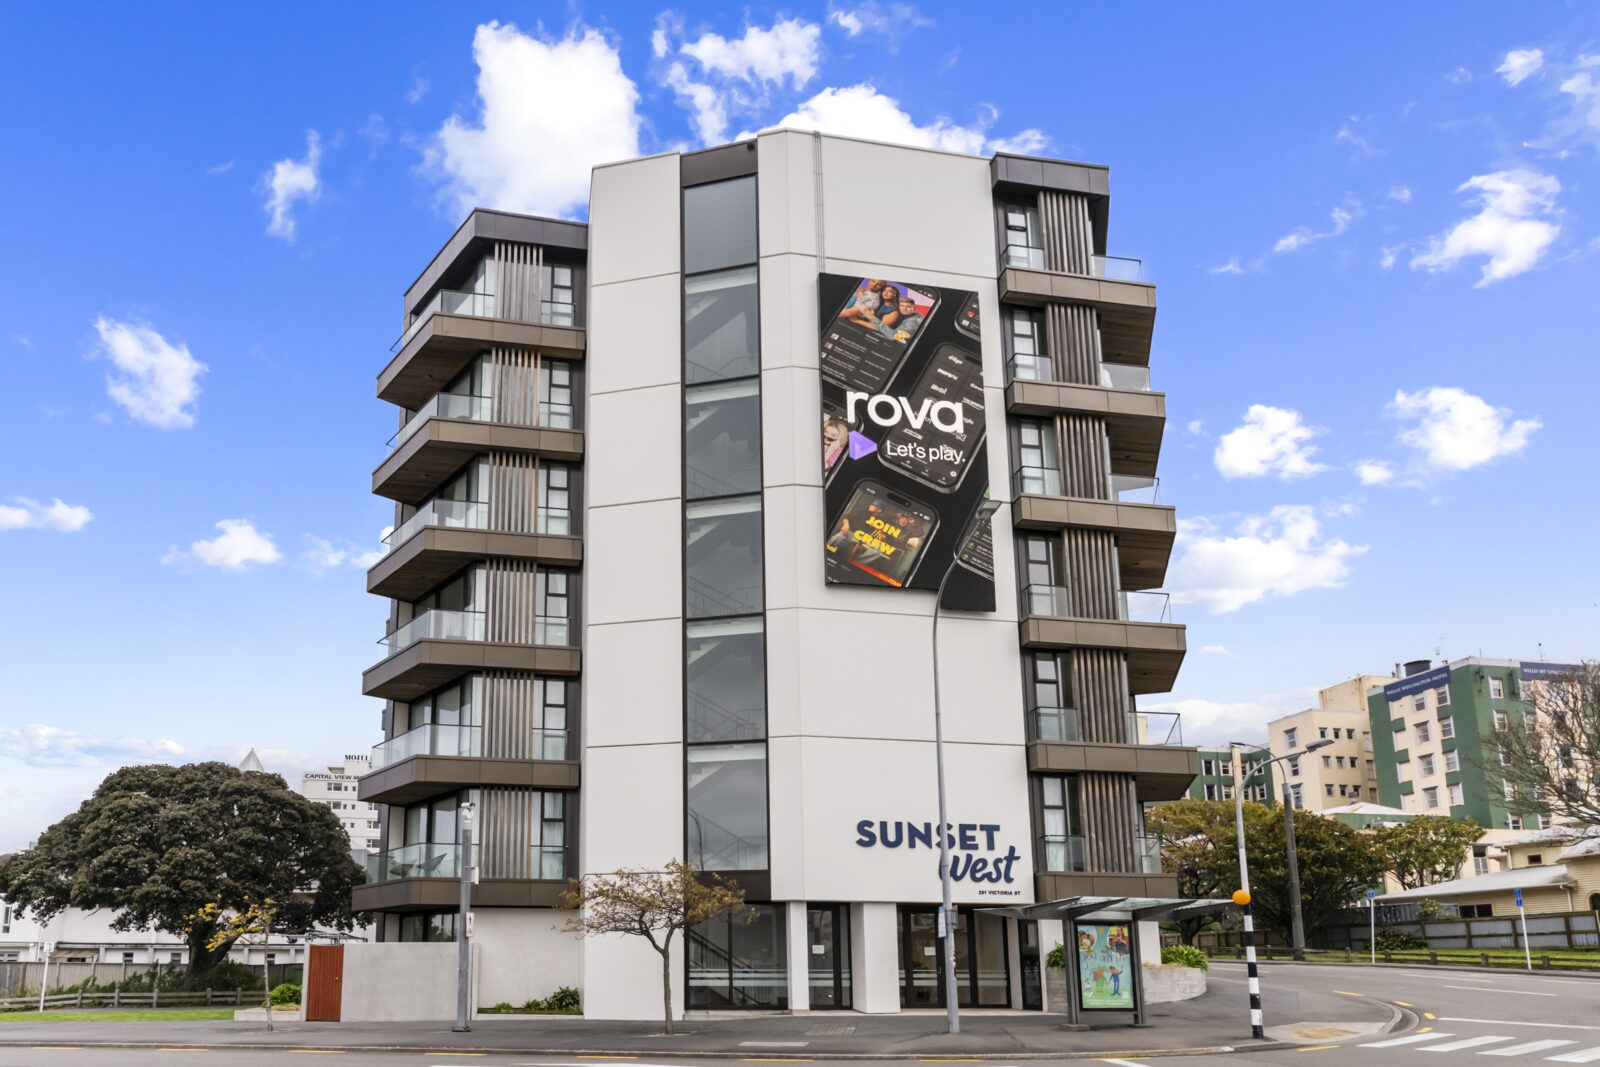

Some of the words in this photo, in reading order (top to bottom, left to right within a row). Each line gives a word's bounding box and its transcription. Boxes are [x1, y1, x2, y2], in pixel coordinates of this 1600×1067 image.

[846, 391, 964, 434] rova
[886, 440, 926, 459] Let's
[929, 444, 966, 465] play.
[865, 516, 901, 538] JOIN
[854, 530, 896, 556] CREW
[855, 820, 1001, 850] SUNSET
